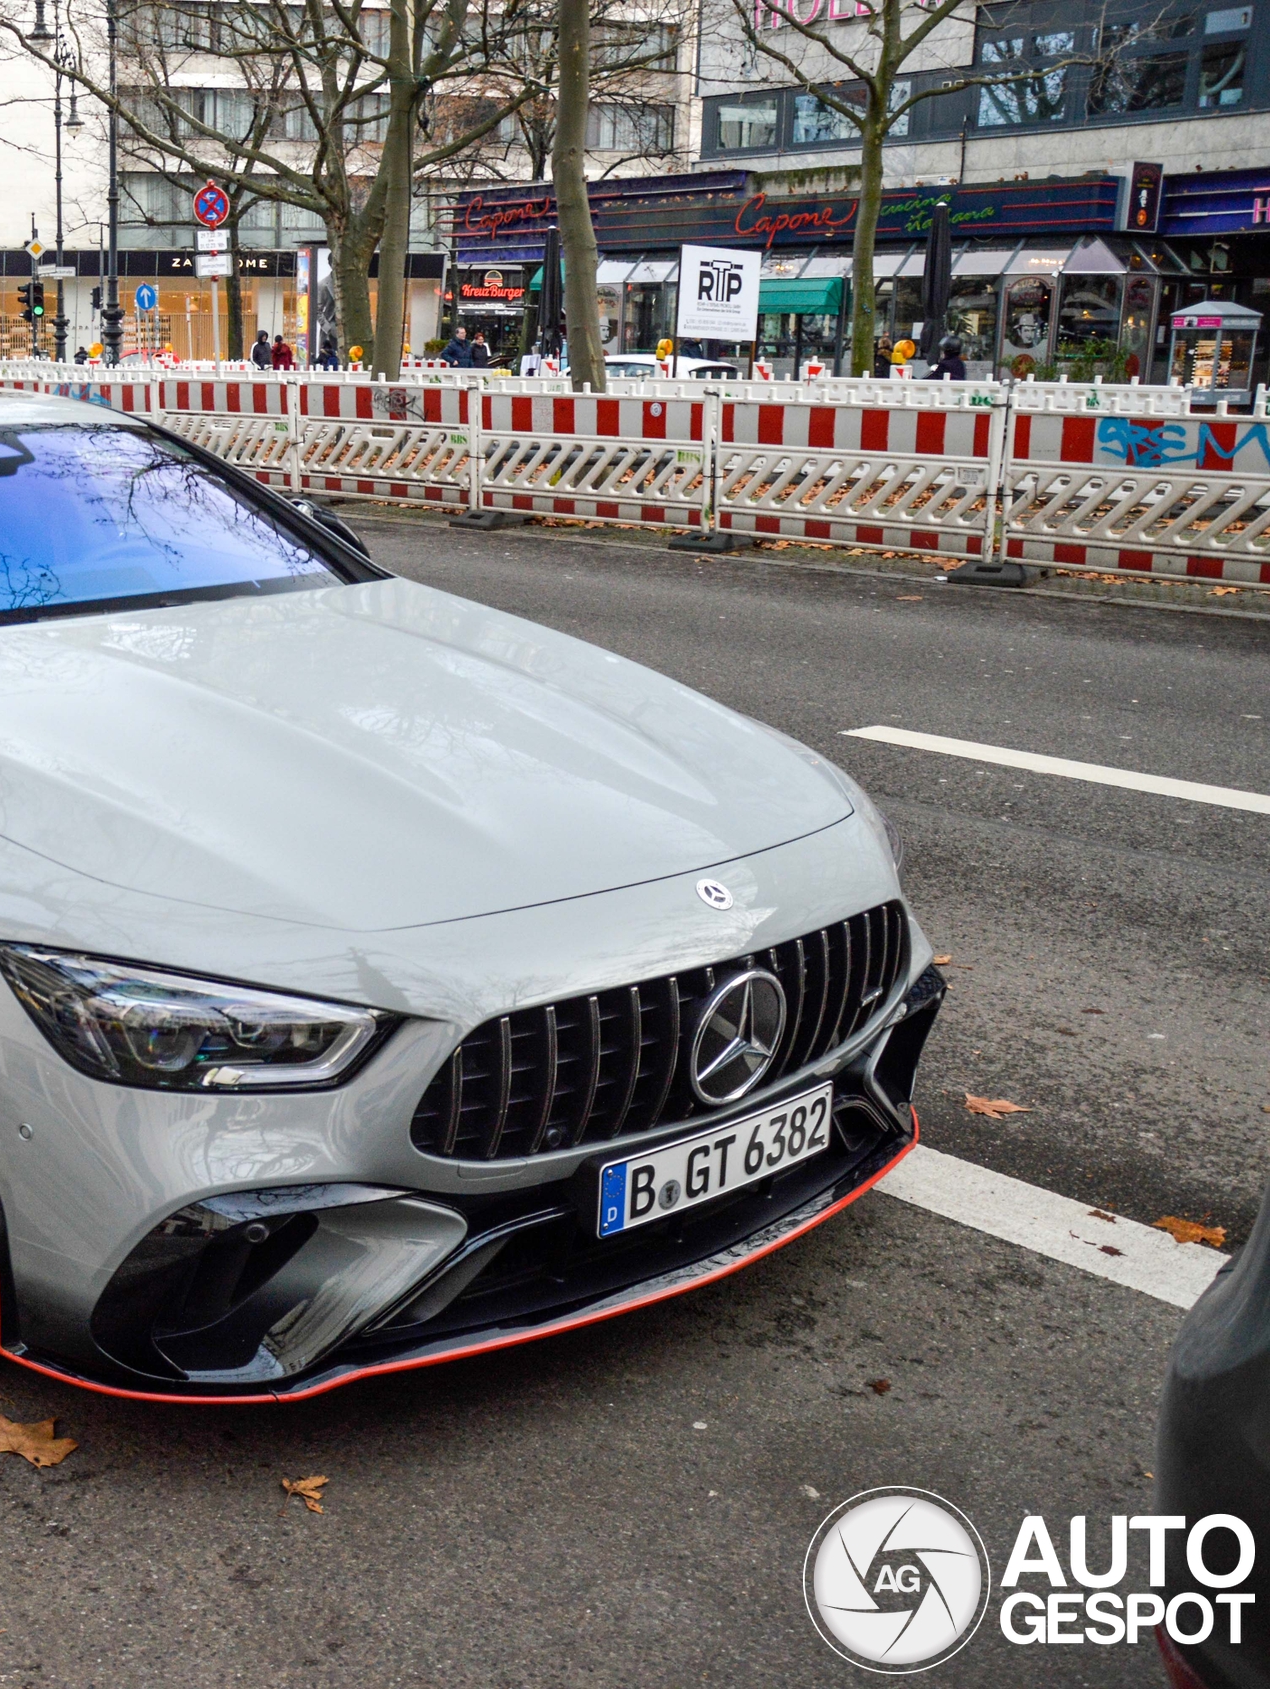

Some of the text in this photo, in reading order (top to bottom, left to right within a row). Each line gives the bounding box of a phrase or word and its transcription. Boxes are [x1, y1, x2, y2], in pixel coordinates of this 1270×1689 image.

[465, 196, 550, 240] Capone
[734, 193, 858, 249] Capone
[880, 194, 952, 216] cucina
[905, 206, 995, 232] itaana
[172, 258, 192, 267] ZA
[239, 259, 268, 268] OME
[698, 260, 743, 302] RTP
[629, 1096, 827, 1219] B GT 6382
[607, 1206, 618, 1222] D
